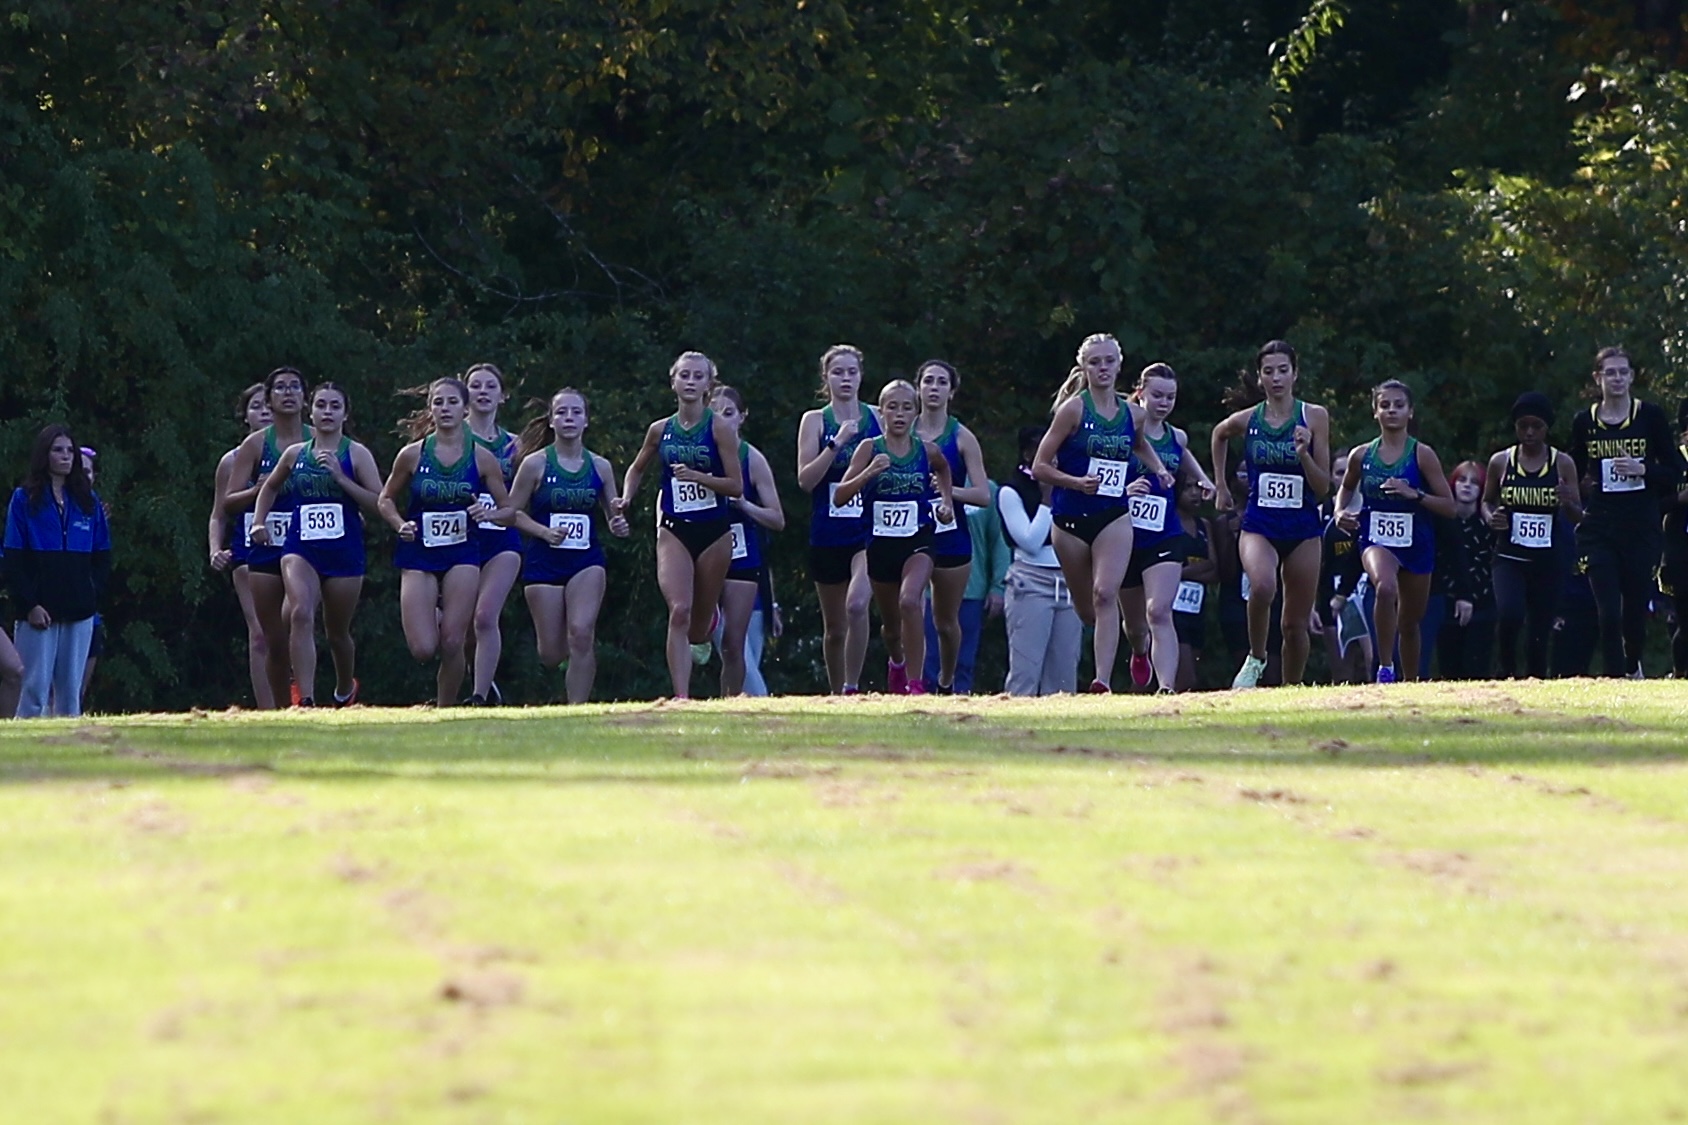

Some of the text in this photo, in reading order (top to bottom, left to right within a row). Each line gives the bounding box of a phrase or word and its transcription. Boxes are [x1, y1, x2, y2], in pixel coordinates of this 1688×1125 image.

[1086, 434, 1131, 459] CNS
[1252, 440, 1301, 465] CNS
[877, 472, 924, 495] CNS
[1096, 466, 1120, 486] 525
[421, 479, 473, 504] CNS
[551, 487, 597, 509] CNS
[679, 483, 707, 502] 536
[1267, 481, 1294, 499] 531
[883, 510, 910, 527] 527
[1131, 500, 1159, 520] 520
[308, 511, 336, 529] 533
[431, 519, 461, 536] 524
[1378, 519, 1405, 537] 535
[1519, 521, 1546, 538] 556
